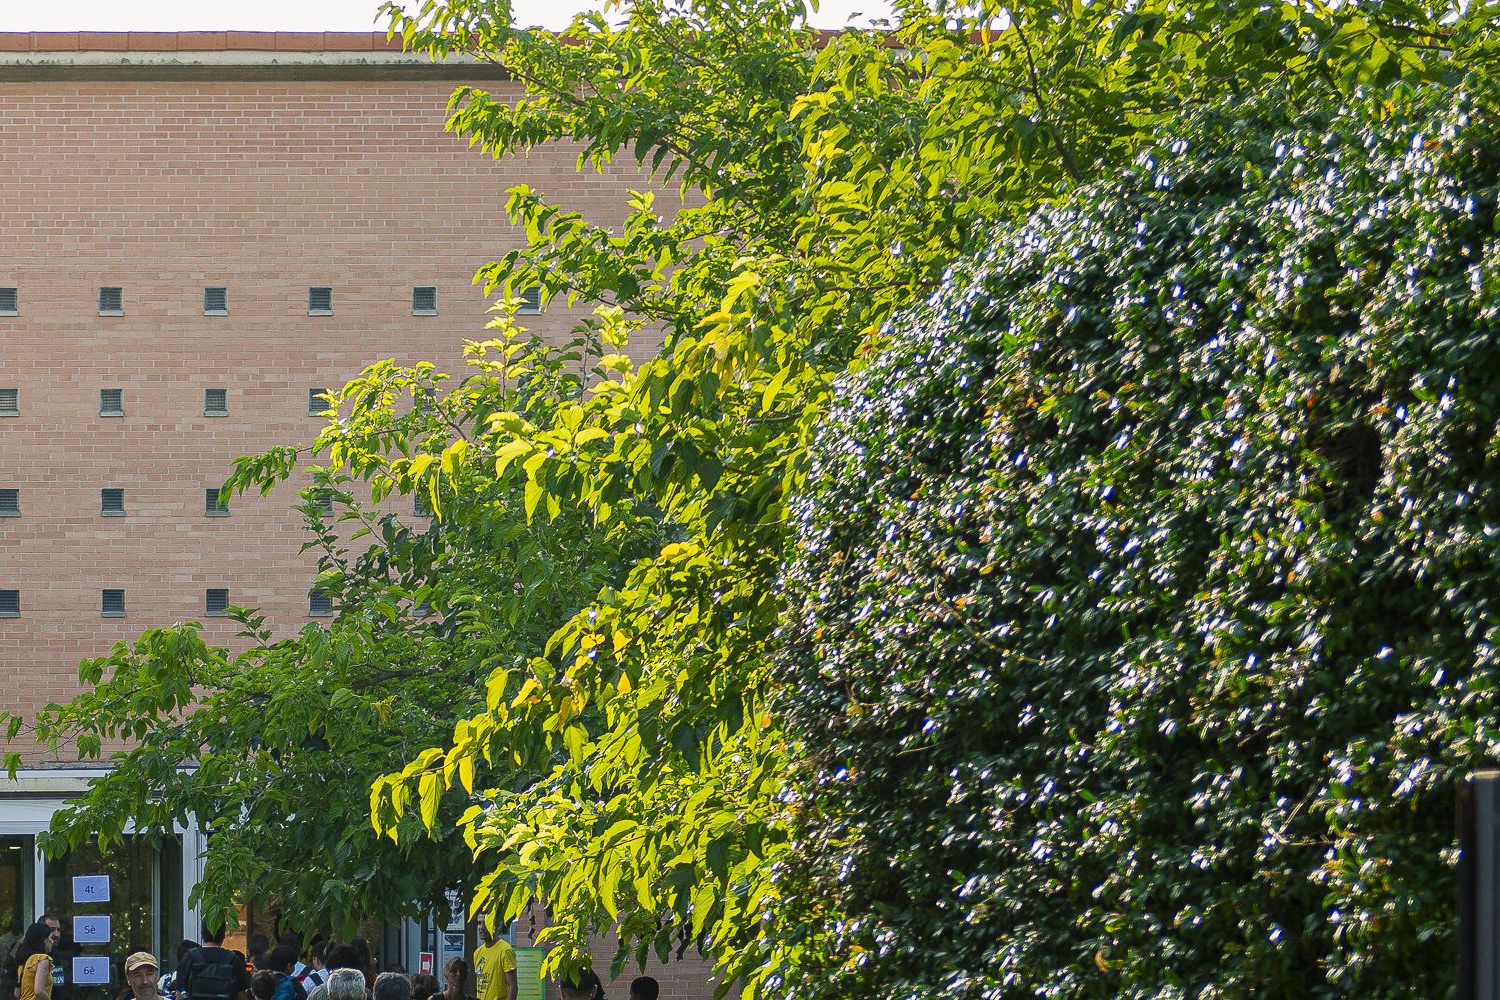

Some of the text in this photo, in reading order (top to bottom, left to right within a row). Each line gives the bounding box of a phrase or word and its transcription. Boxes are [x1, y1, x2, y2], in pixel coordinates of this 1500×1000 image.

[84, 885, 95, 894] 4t
[84, 925, 96, 934] 5è
[83, 966, 96, 975] 6è
